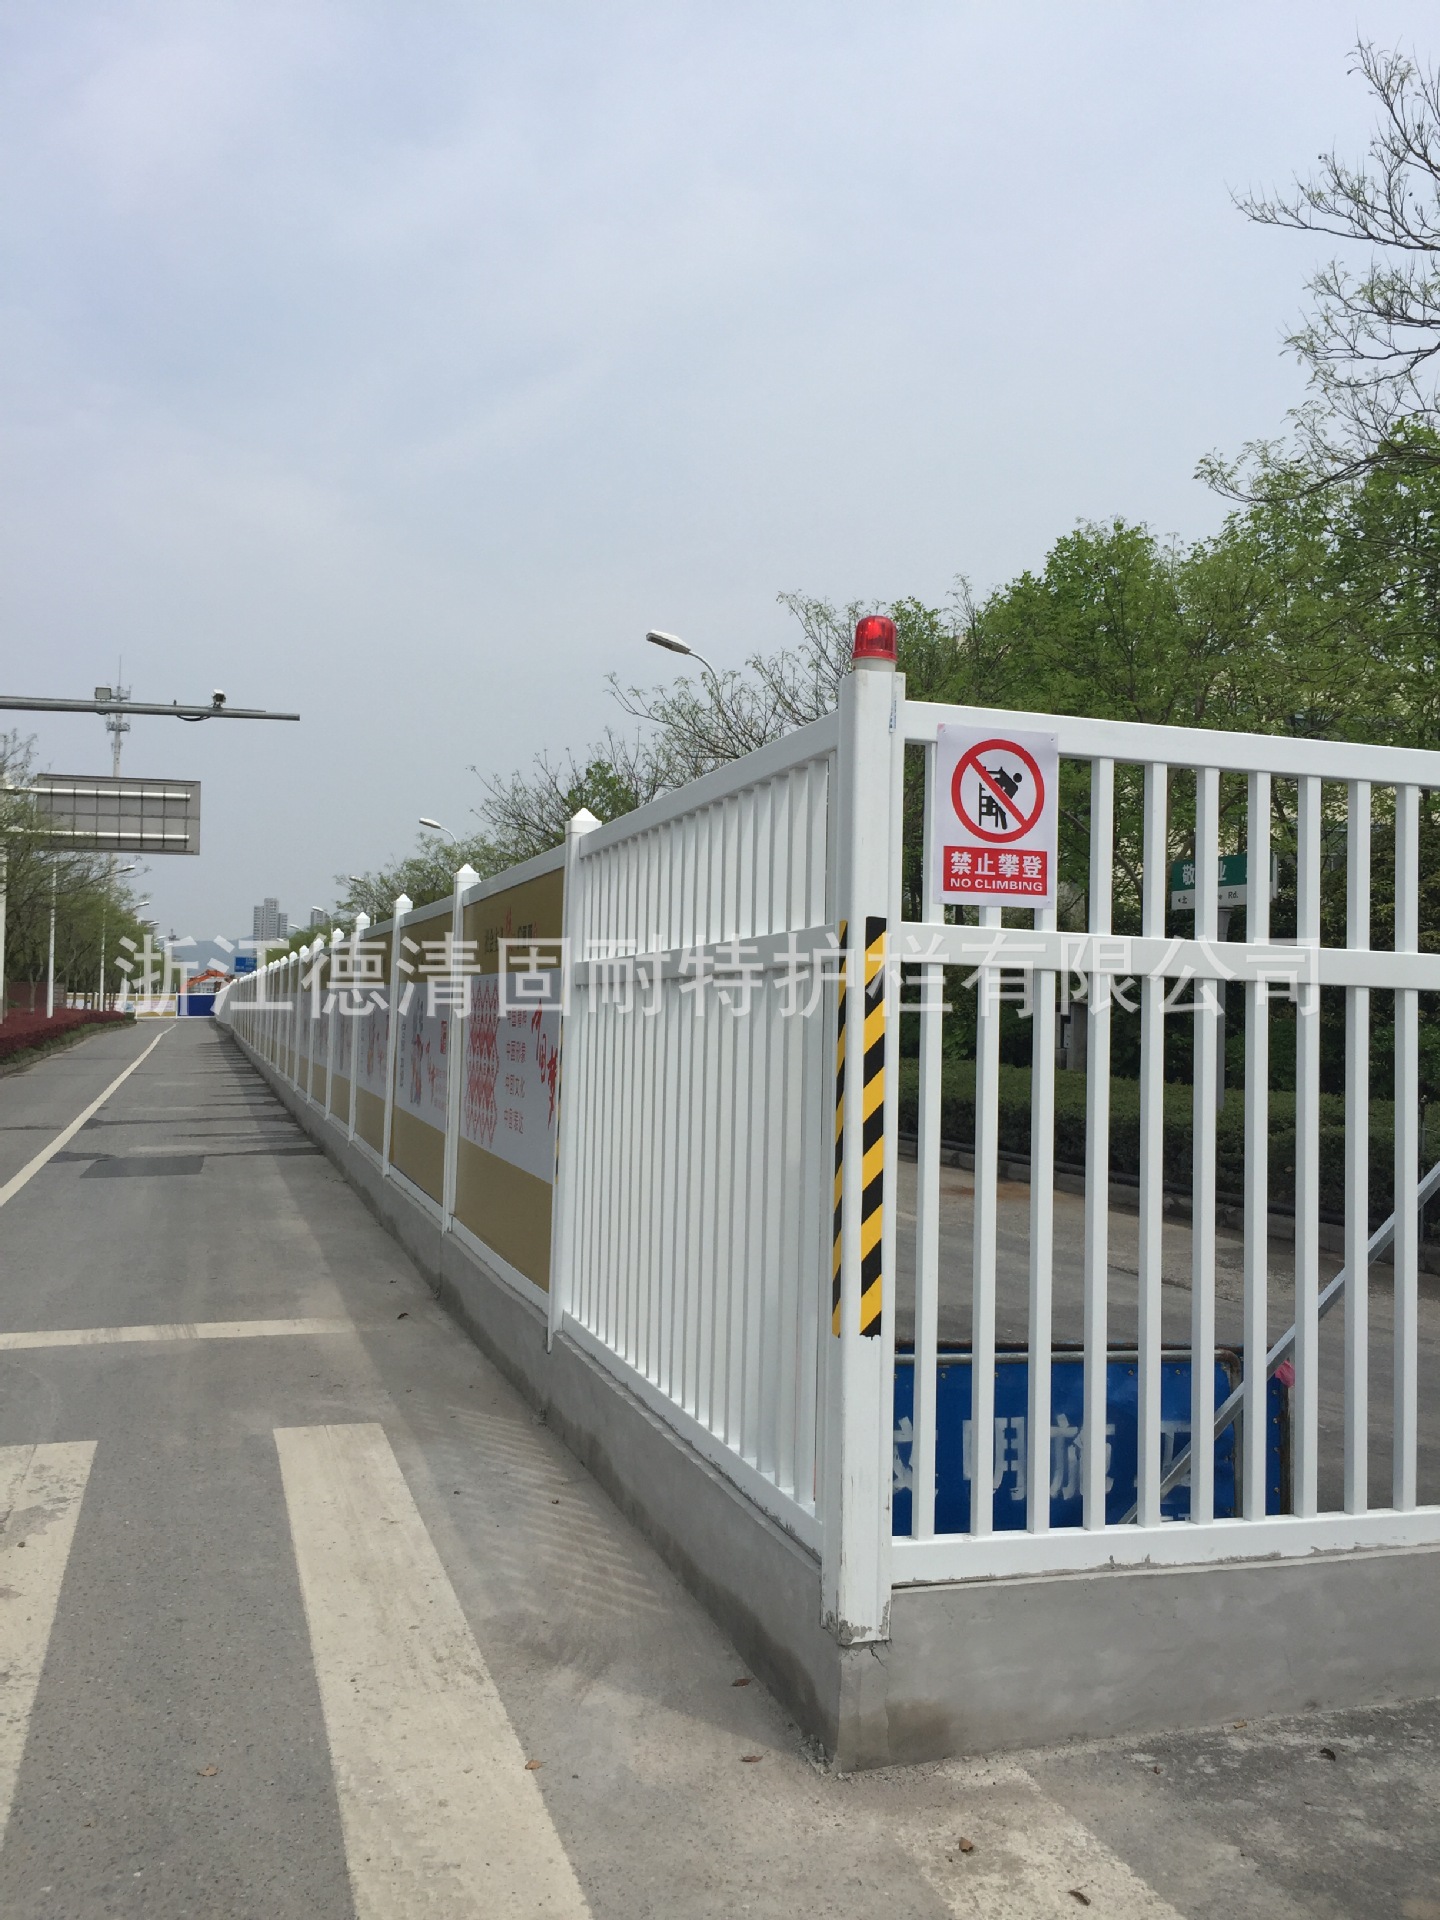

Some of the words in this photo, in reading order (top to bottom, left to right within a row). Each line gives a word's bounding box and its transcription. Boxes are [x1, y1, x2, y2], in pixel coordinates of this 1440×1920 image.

[951, 851, 1042, 879] 禁止攀登
[950, 878, 972, 888] NO
[974, 878, 1043, 892] CLIMBING
